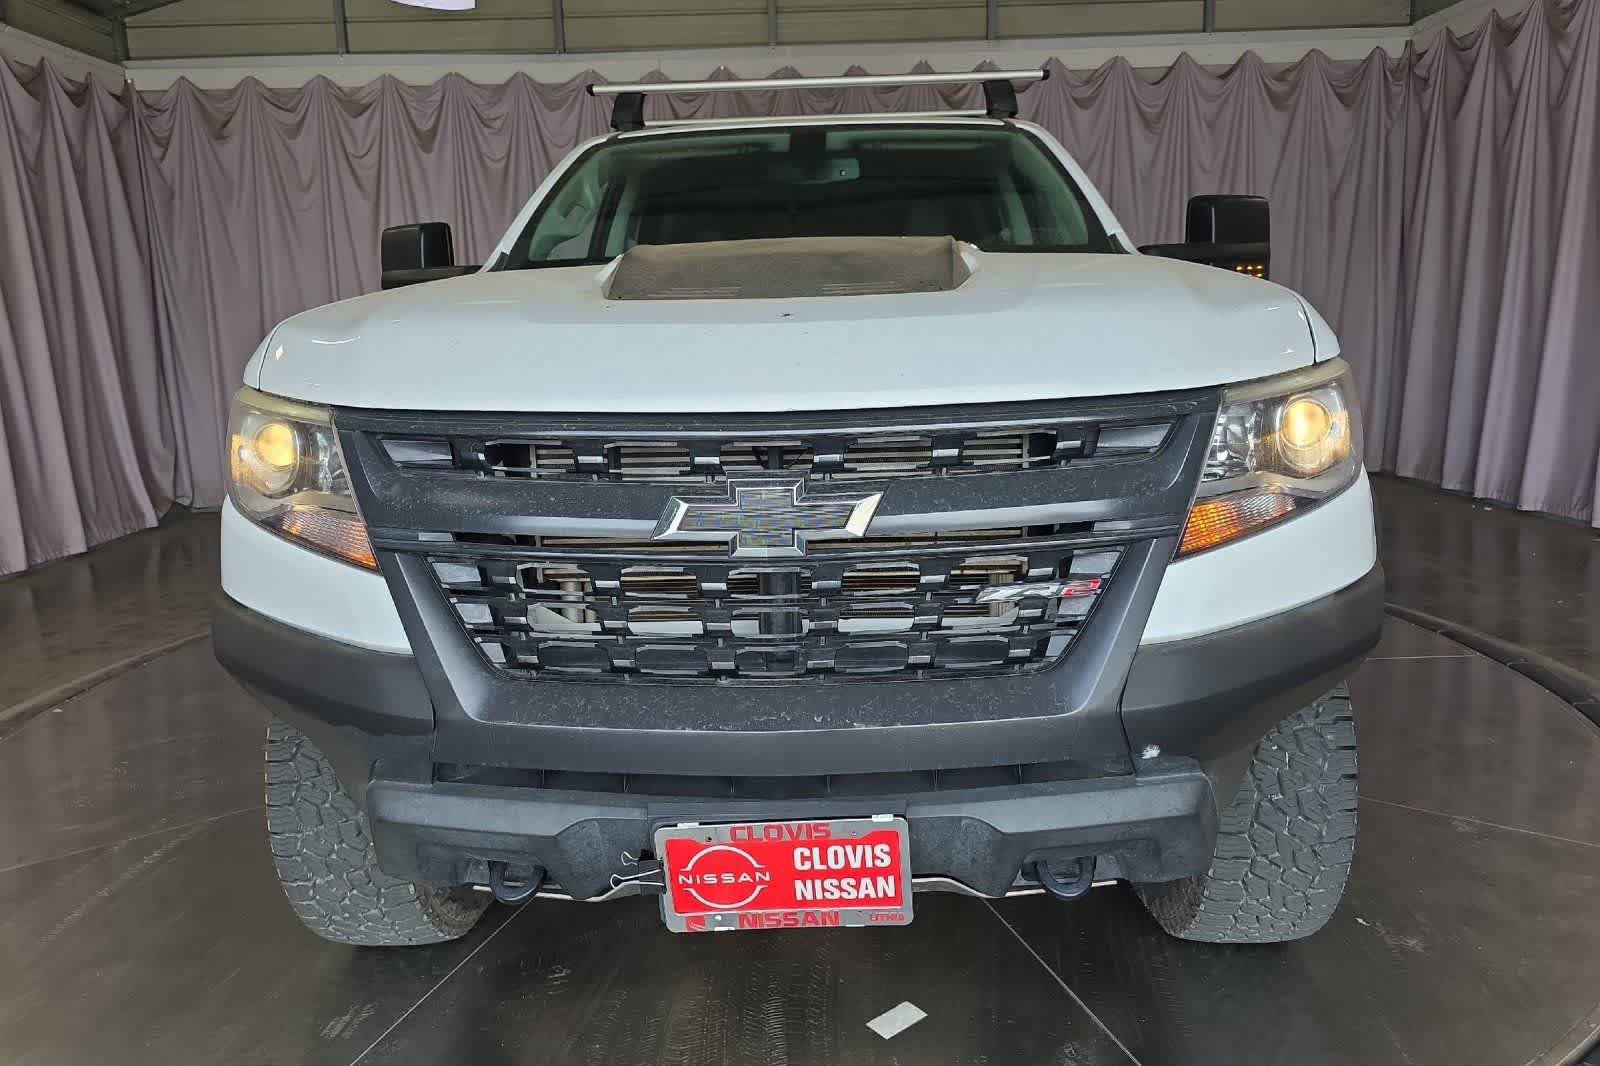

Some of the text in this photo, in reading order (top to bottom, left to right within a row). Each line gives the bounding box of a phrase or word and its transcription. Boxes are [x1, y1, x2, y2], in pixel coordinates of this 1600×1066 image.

[730, 823, 832, 843] CLOVIS
[793, 844, 891, 871] CLOVIS
[678, 871, 771, 886] NISSAN
[795, 875, 895, 901] NISSAN
[738, 911, 840, 929] NISSAN
